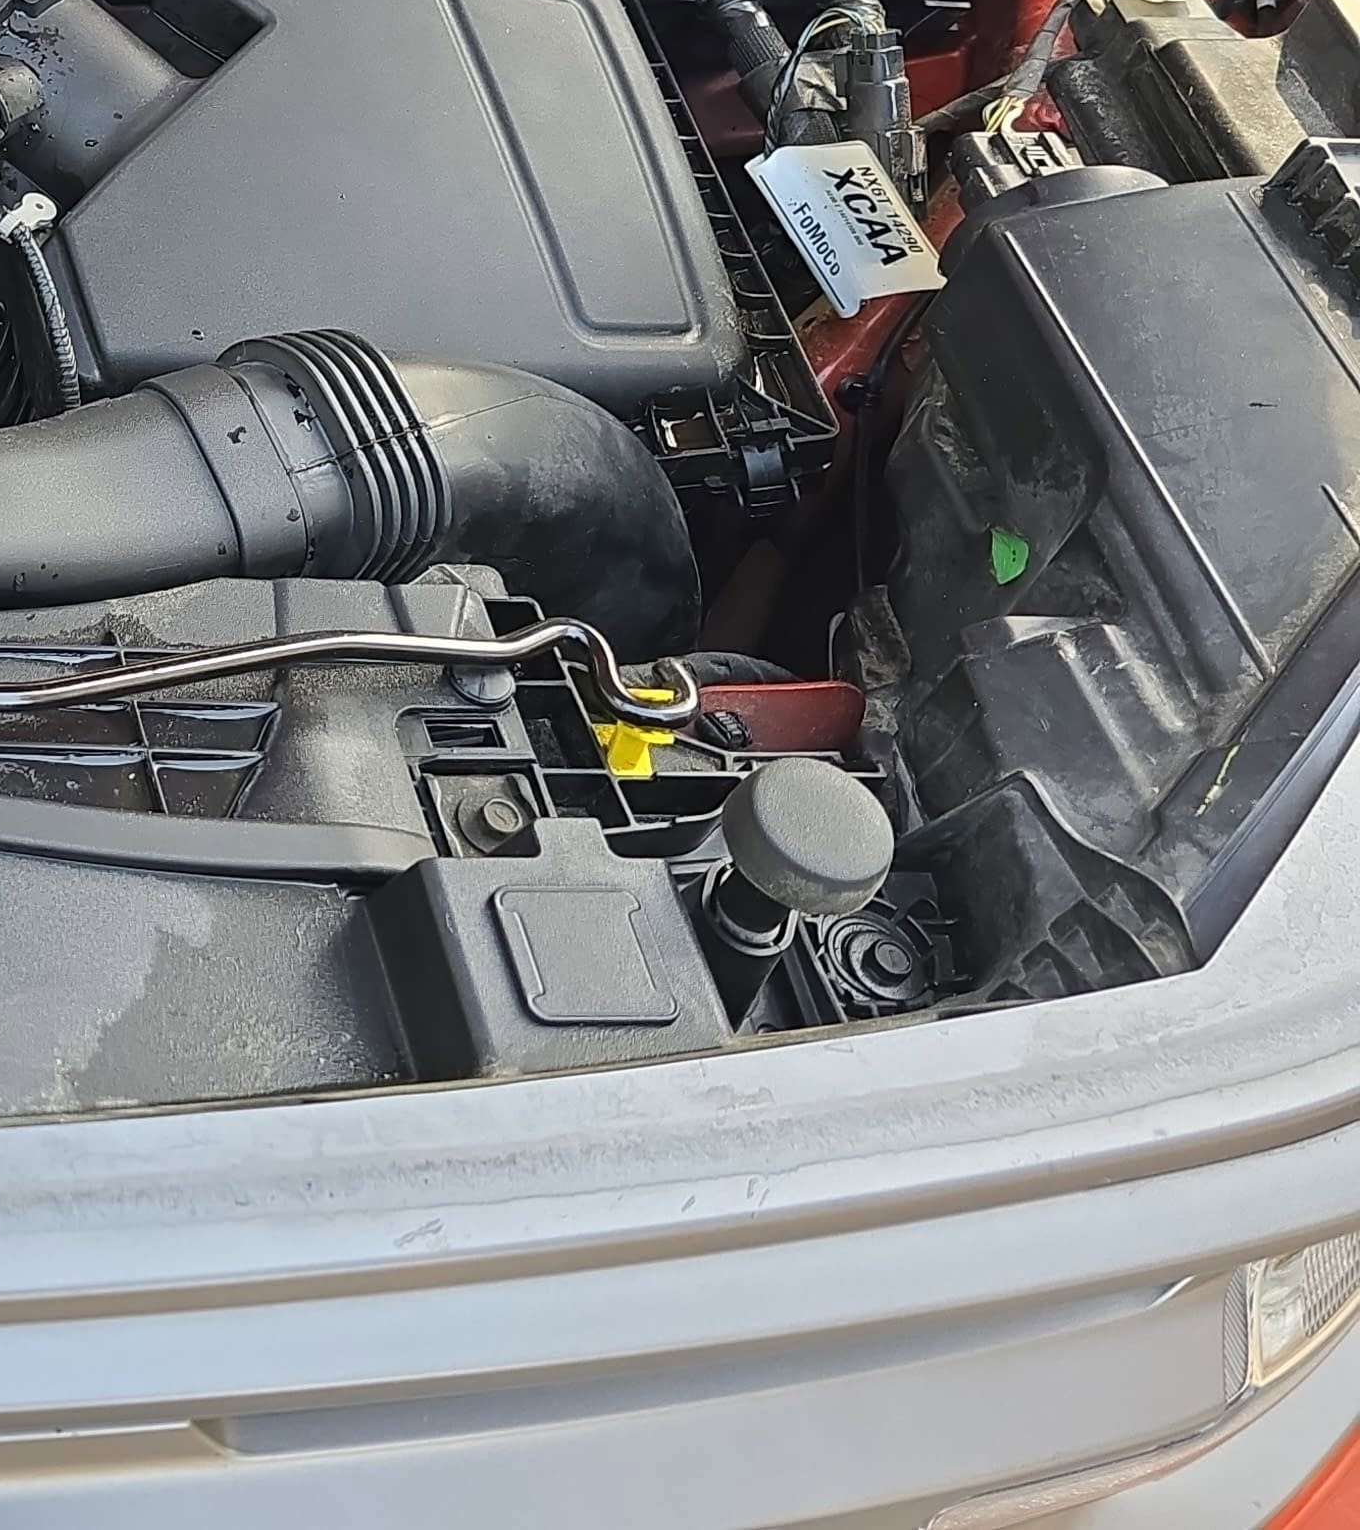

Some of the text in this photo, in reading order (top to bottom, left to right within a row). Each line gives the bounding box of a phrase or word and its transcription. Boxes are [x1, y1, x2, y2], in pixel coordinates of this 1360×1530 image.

[792, 201, 841, 277] FoMoCo
[821, 167, 909, 267] XCAA
[885, 210, 925, 255] 14290
